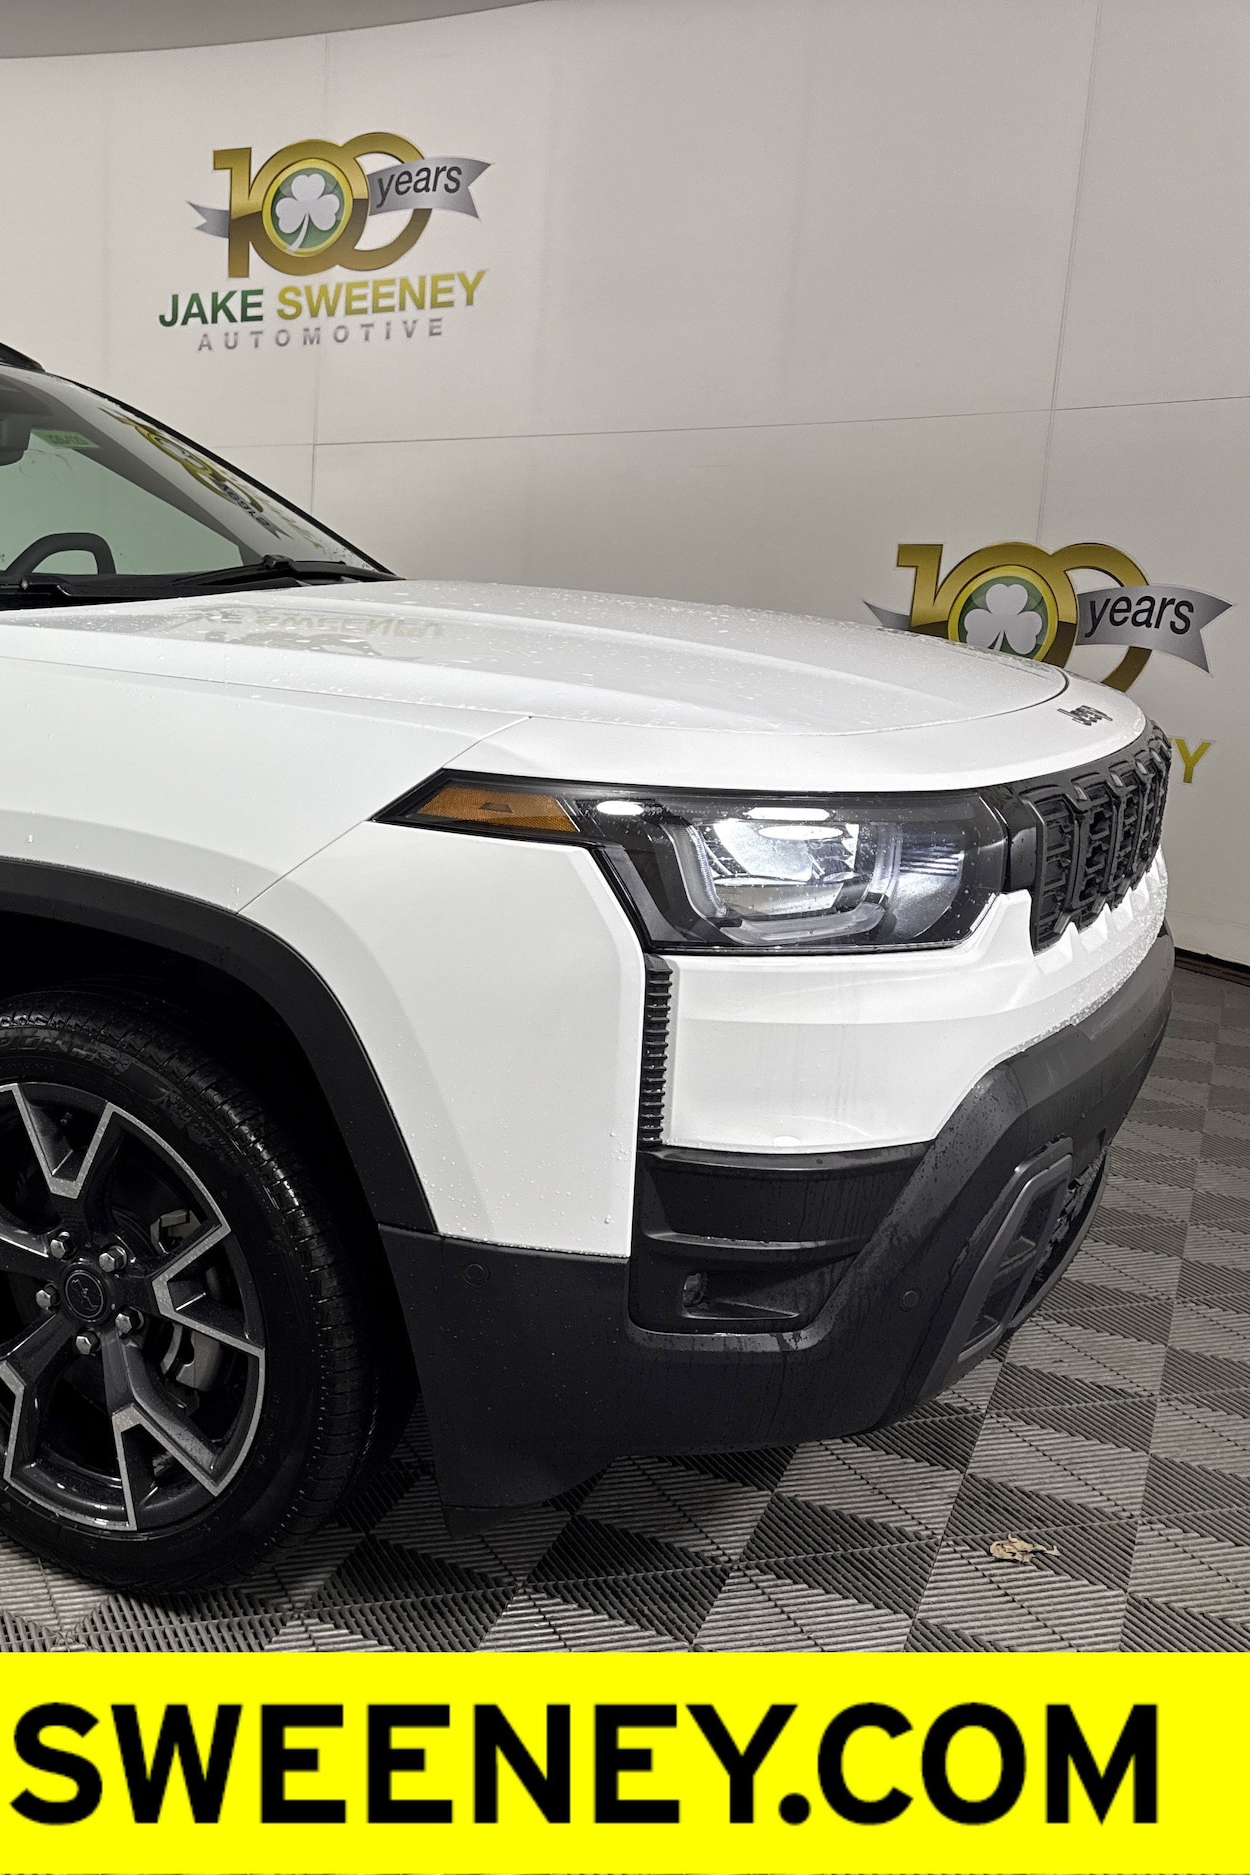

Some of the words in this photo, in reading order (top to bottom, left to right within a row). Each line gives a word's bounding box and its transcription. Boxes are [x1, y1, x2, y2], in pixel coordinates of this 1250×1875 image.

[212, 131, 433, 279] 100
[375, 165, 462, 208] years
[159, 289, 264, 327] JAKE
[276, 270, 487, 320] SWEENEY
[198, 318, 443, 351] AUTOMOTIVE
[1084, 595, 1194, 638] years
